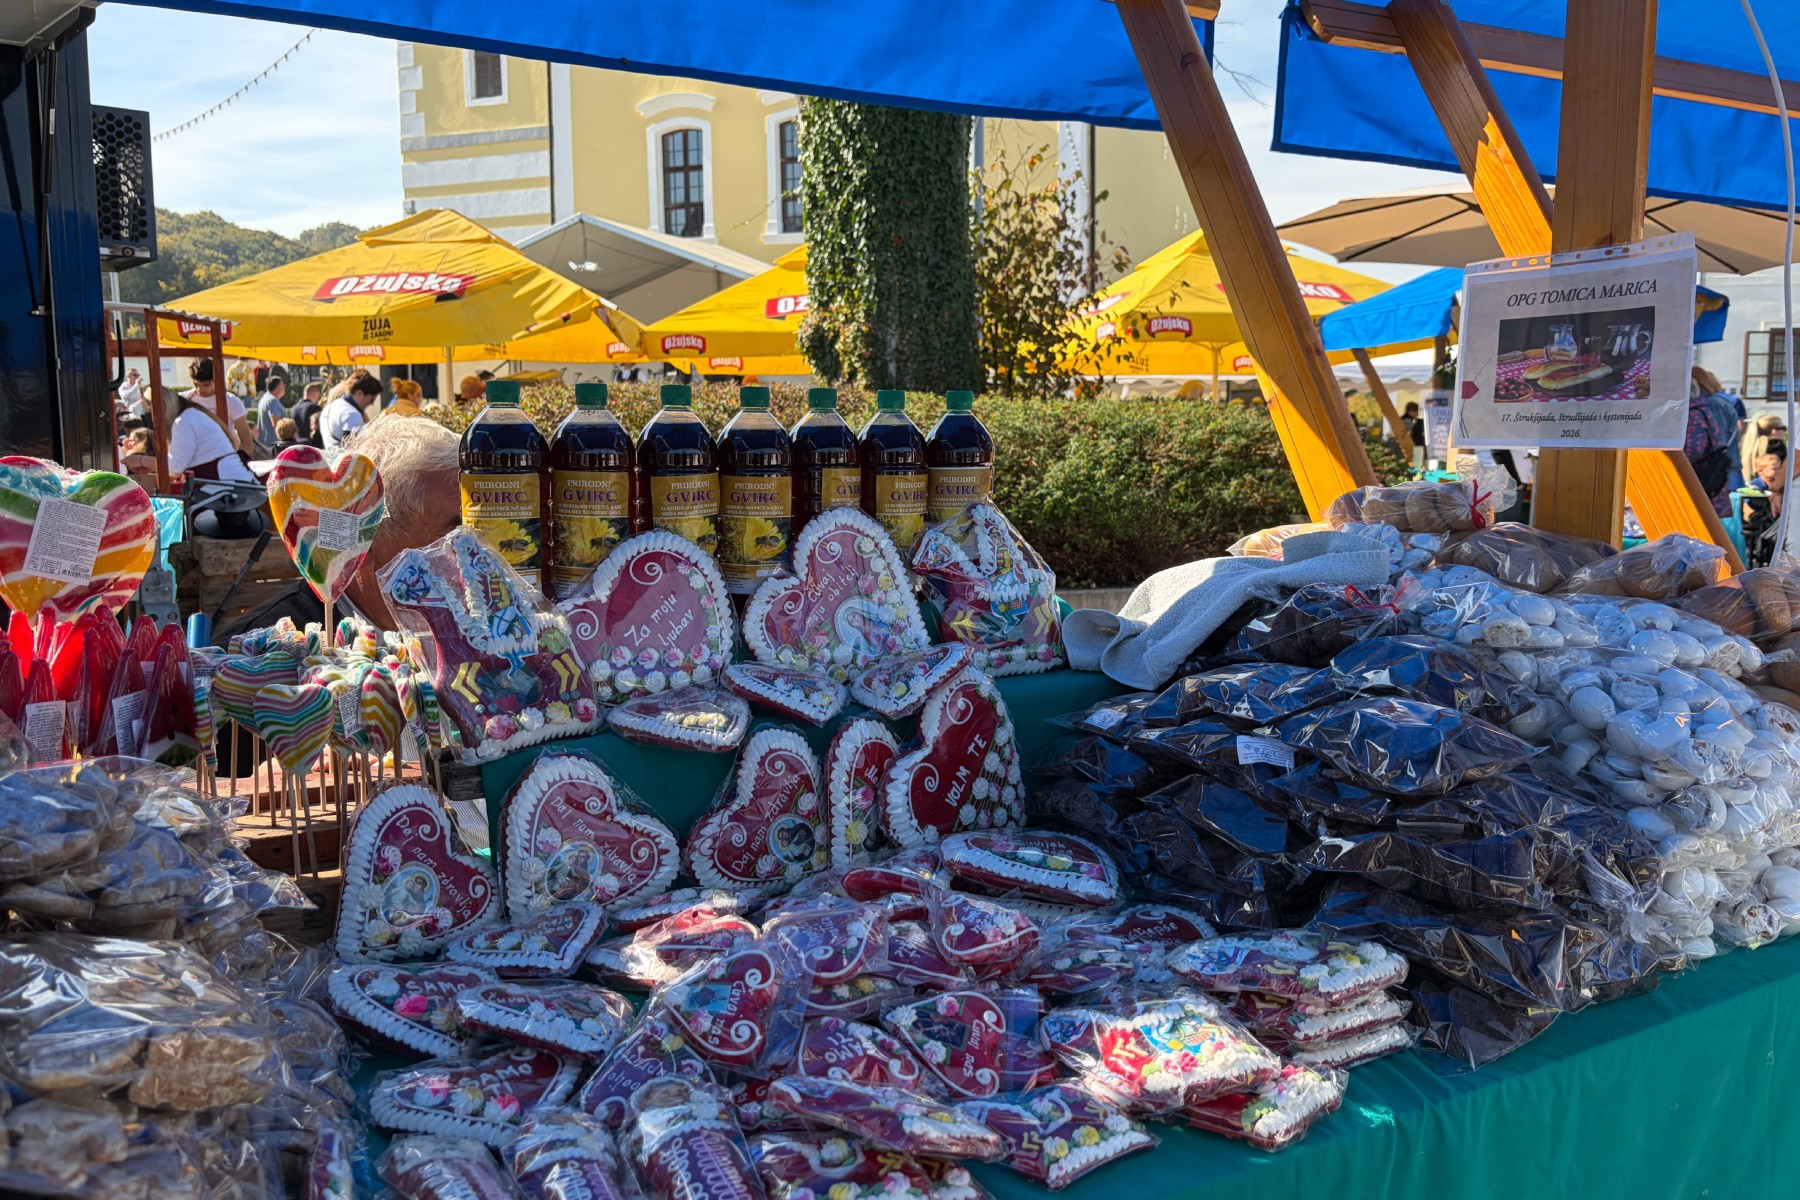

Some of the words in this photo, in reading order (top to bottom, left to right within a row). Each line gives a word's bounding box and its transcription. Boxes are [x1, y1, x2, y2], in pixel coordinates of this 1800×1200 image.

[330, 273, 462, 295] Ožujsko
[1507, 292, 1537, 307] OPG
[1540, 286, 1596, 305] TOMICA
[1599, 279, 1658, 299] MARICA
[363, 317, 391, 332] ŽUJA
[1151, 317, 1190, 331] Ožujsko
[665, 335, 703, 349] Ožujsko
[1603, 411, 1642, 423] kestenijada
[1560, 429, 1580, 438] 2026.
[474, 481, 520, 489] PRIRODNI
[567, 480, 611, 488] PRIRODNI
[671, 481, 710, 489] PRIRODNI
[936, 485, 980, 495] GVIRC
[470, 491, 527, 504] GVIRC
[563, 489, 618, 503] GVIRC
[666, 490, 714, 504] GVIRC
[730, 491, 780, 503] GVIRC
[623, 624, 651, 647] Za
[650, 593, 678, 624] moju
[807, 605, 826, 628] moju
[967, 733, 987, 757] TE
[731, 849, 756, 873] Daj
[750, 825, 769, 852] nam
[767, 773, 801, 823] zdravlja
[549, 796, 576, 820] Daj
[573, 818, 596, 839] nam
[600, 842, 638, 884] zdravlja
[396, 814, 418, 846] Daj
[412, 846, 438, 869] nam
[438, 871, 473, 920] zdravlja
